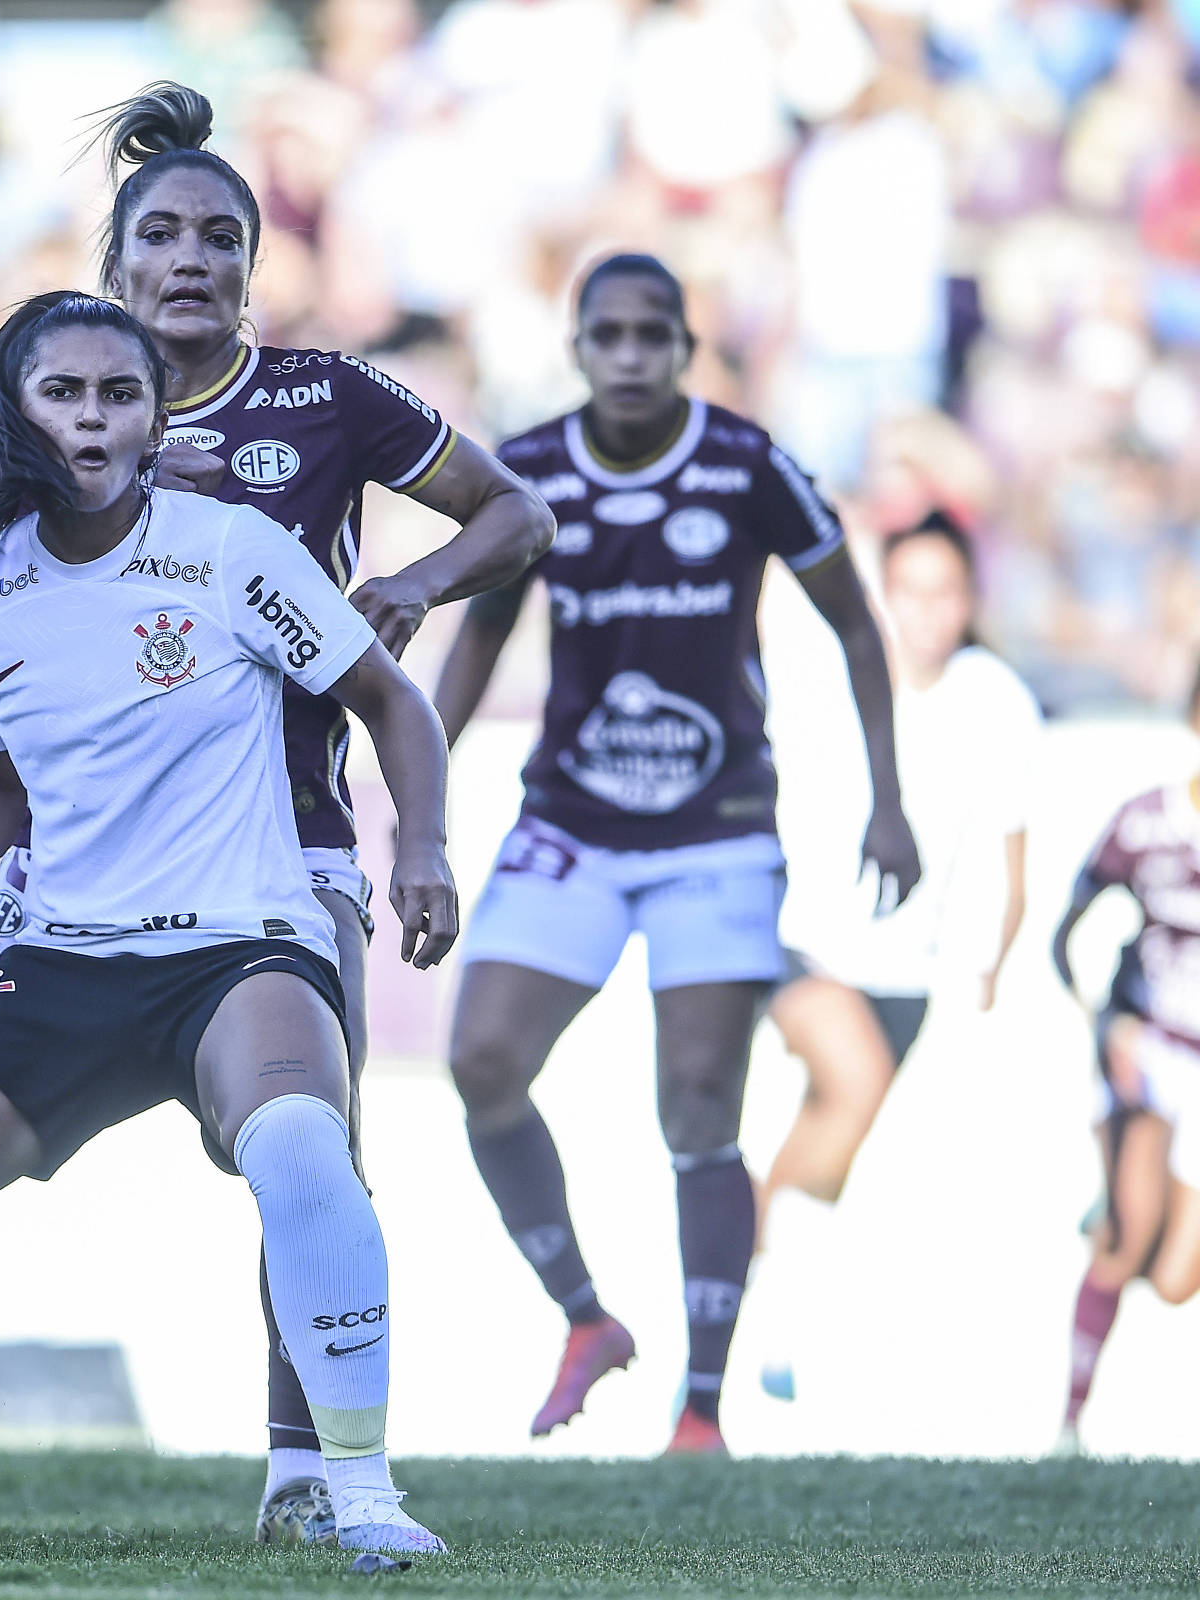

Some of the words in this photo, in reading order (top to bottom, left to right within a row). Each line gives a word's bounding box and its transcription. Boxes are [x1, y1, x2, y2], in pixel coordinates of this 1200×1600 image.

[273, 379, 332, 409] ADN
[120, 554, 214, 587] pixbet
[257, 590, 321, 669] bmg
[284, 598, 324, 641] CORINTHIANS
[311, 1304, 387, 1330] SCCP
